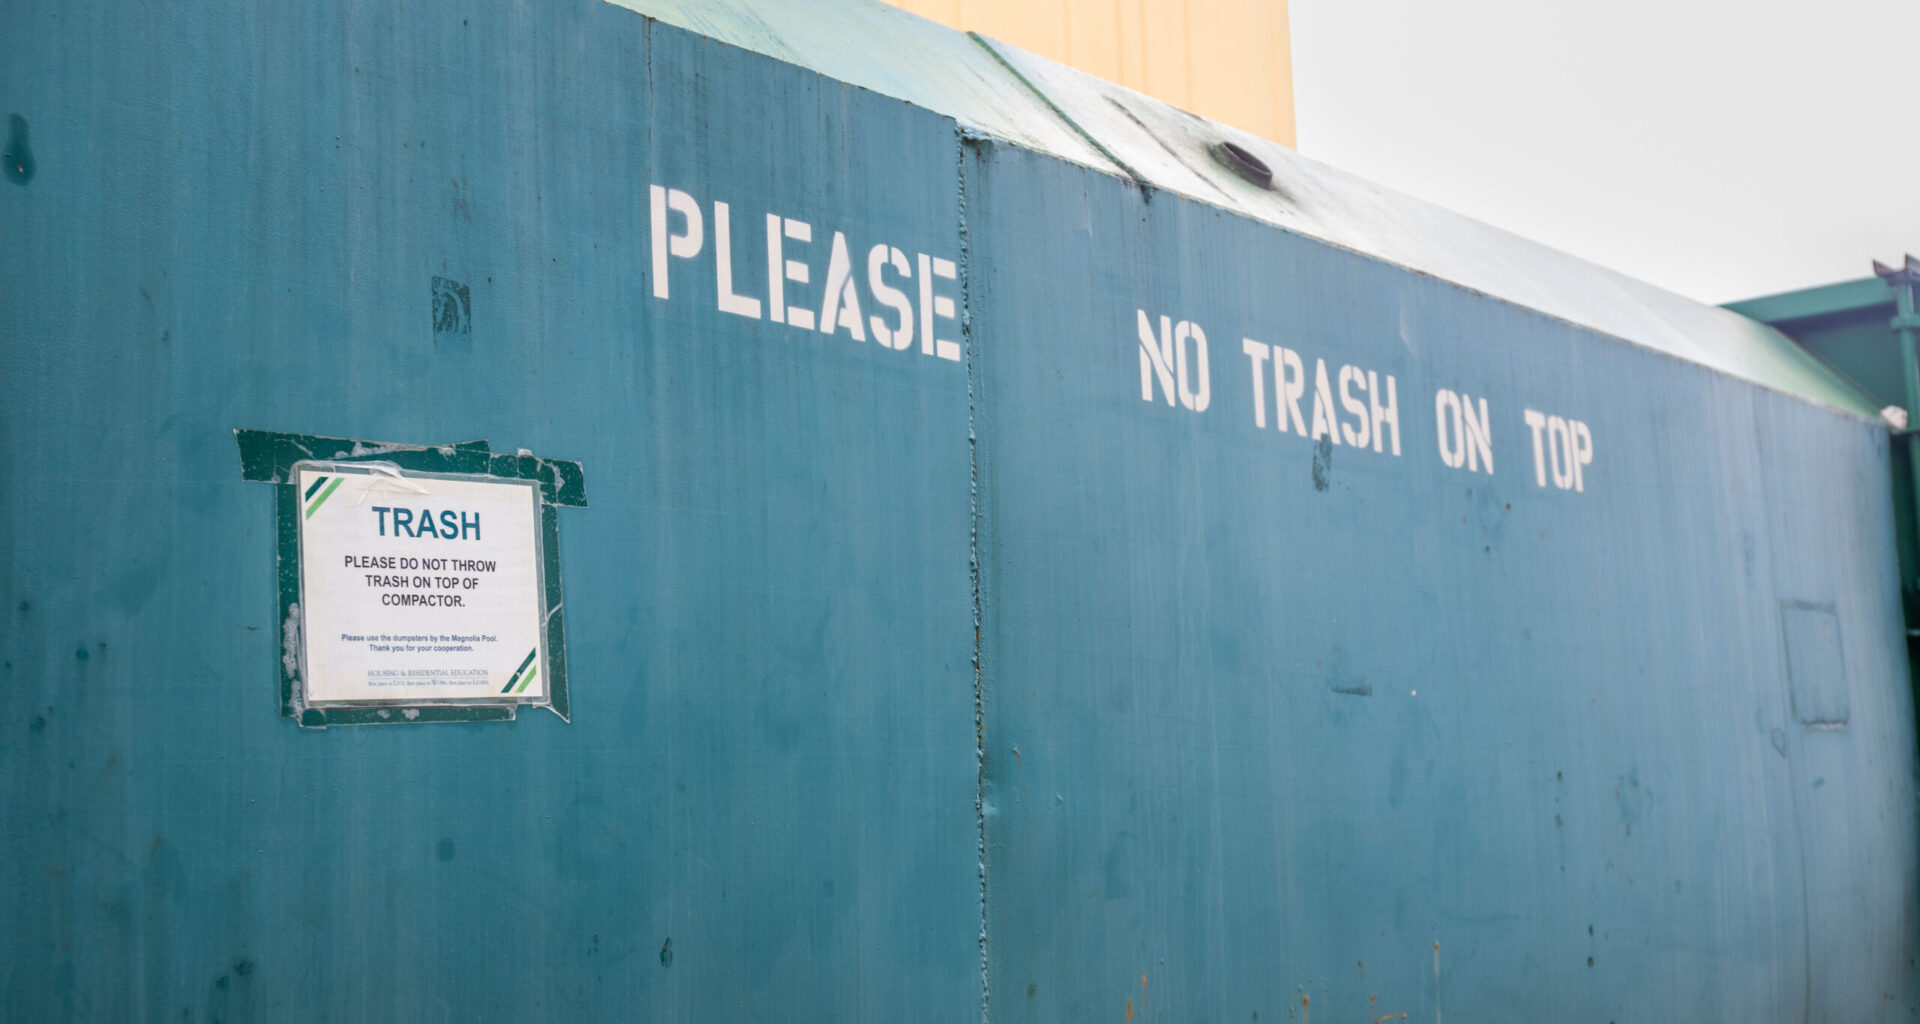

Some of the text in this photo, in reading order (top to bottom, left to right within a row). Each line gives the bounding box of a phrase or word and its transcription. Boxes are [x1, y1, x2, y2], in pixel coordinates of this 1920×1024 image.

[650, 184, 1594, 492] PLEASE NO TRASH ON TOP
[372, 506, 481, 541] TRASH
[344, 555, 497, 572] PLEASE DO NOT THROW
[365, 574, 479, 590] TRASH ON TOP OF
[381, 593, 466, 607] COMPACTOR.
[341, 633, 365, 642] Please
[380, 634, 392, 642] the
[392, 634, 428, 644] dumpsters
[429, 634, 438, 644] by
[439, 634, 450, 642] the
[451, 634, 481, 644] Magnolia
[481, 634, 498, 642] Pool.
[369, 644, 475, 653] Thank you for your cooperation.
[367, 669, 400, 677] HOUSING
[407, 669, 449, 677] RESIDENTIAL
